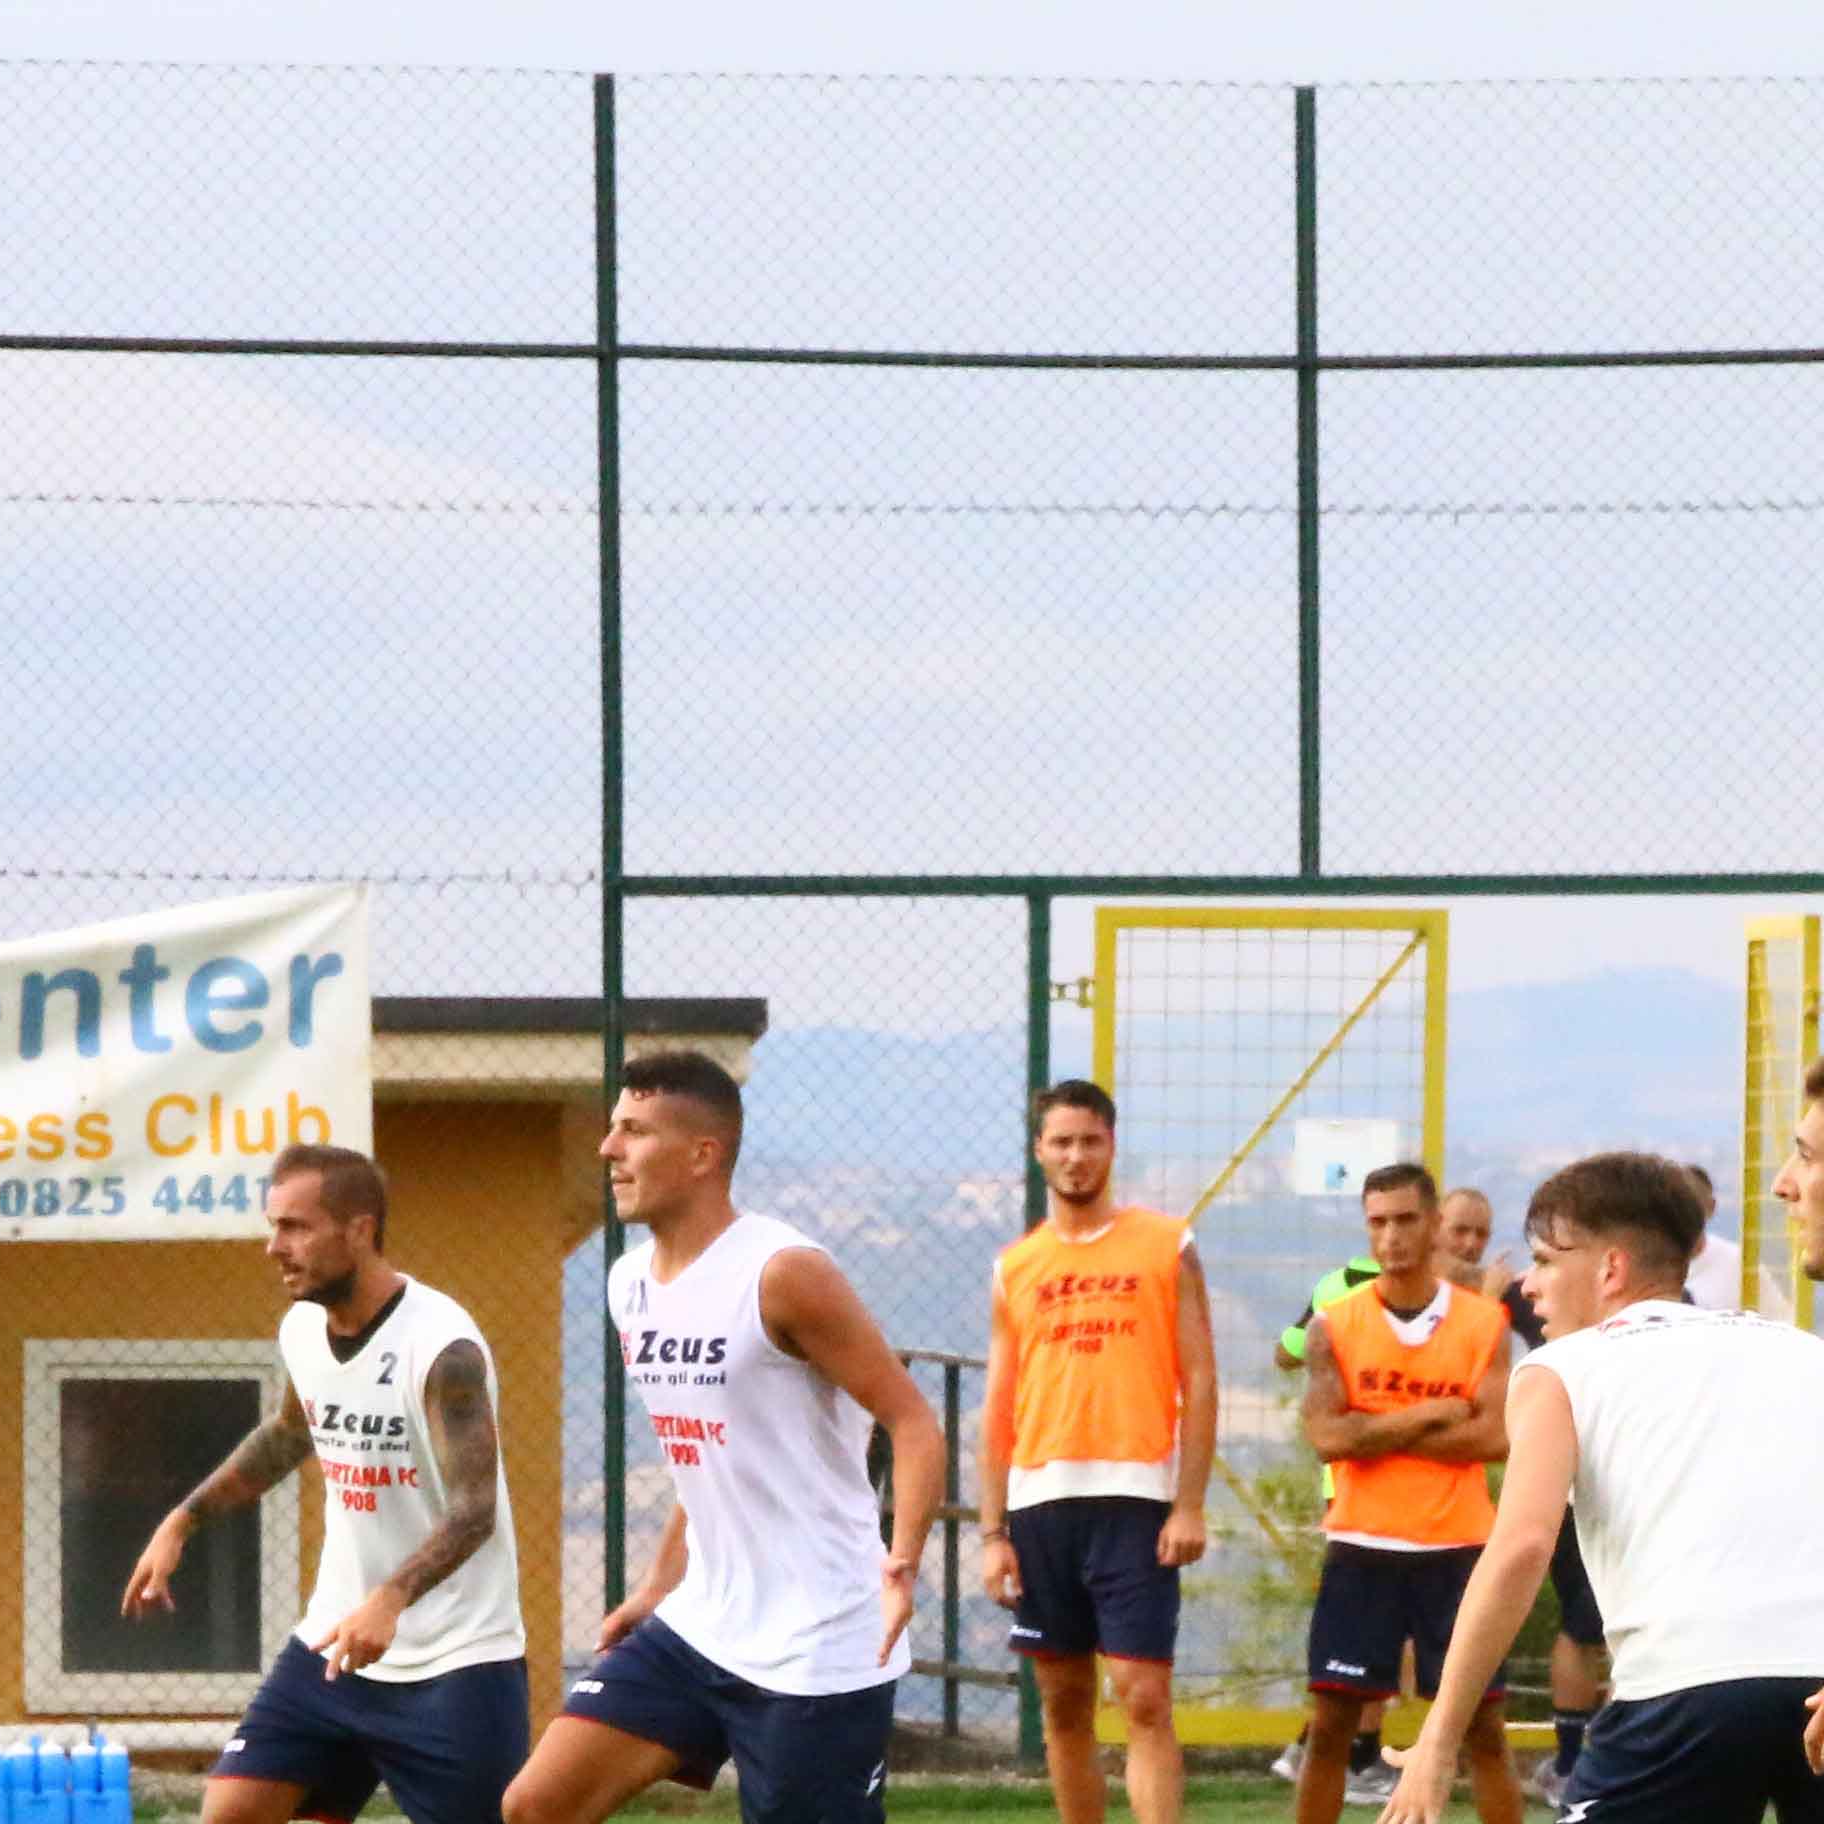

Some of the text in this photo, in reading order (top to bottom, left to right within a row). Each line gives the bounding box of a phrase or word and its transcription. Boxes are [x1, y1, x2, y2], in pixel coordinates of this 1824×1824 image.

[144, 1090, 333, 1159] Club
[635, 1330, 728, 1365] Zeus
[376, 1351, 399, 1385] 2
[321, 1403, 406, 1437] Zeus
